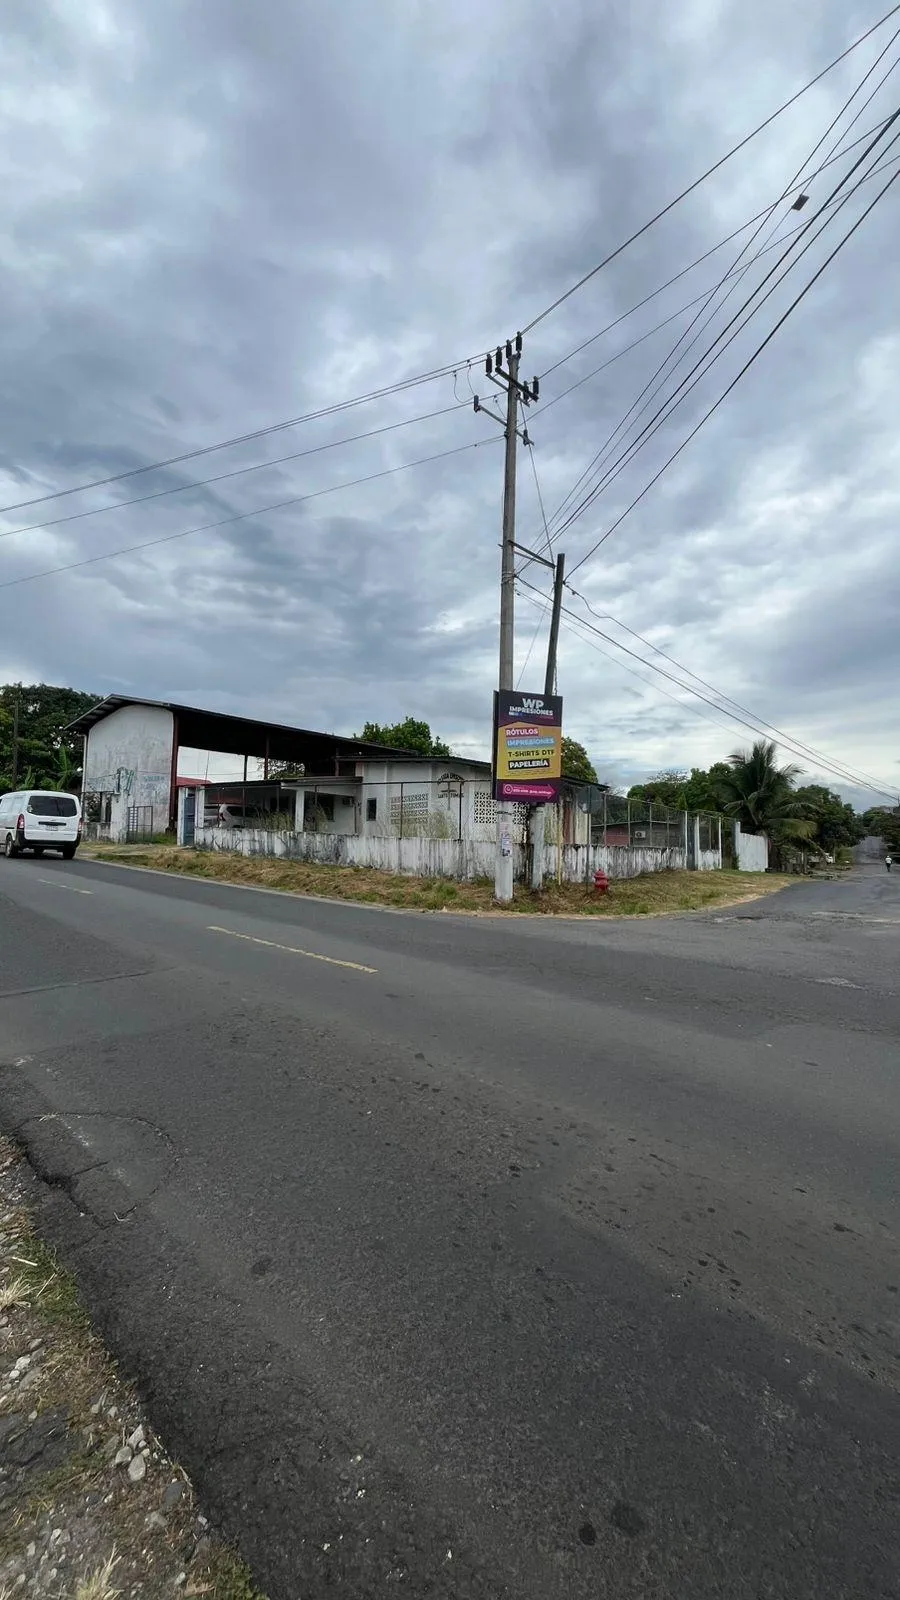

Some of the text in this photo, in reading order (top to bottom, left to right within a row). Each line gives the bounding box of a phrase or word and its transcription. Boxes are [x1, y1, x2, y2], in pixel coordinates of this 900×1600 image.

[522, 698, 544, 708] WP
[509, 706, 554, 716] IMPRESIONES
[506, 728, 538, 736] RÓTULOS
[507, 738, 554, 747] IMPRESIONES
[508, 749, 540, 757] T-SHIRTS
[509, 759, 549, 768] PAPELERÍA
